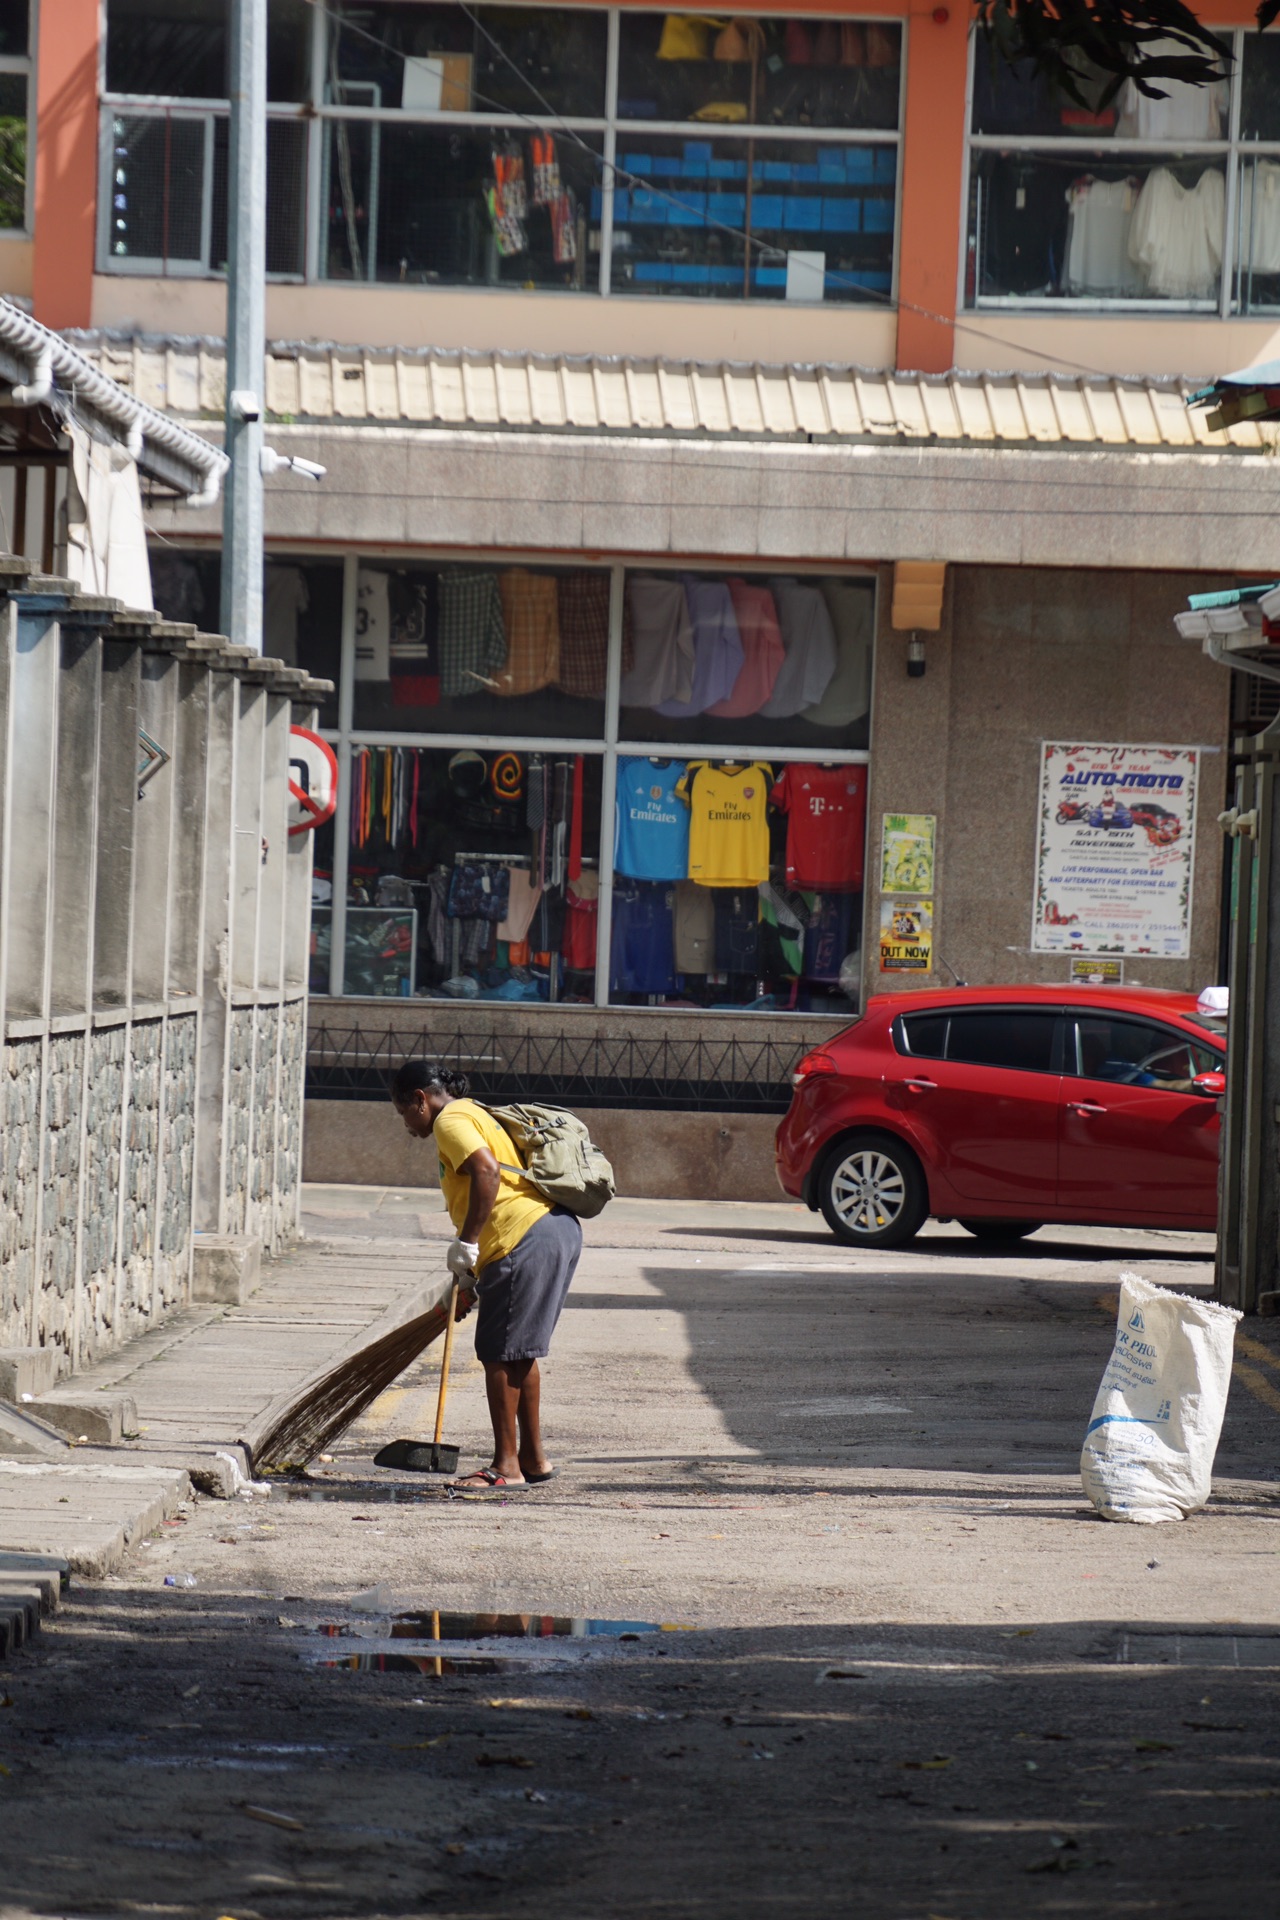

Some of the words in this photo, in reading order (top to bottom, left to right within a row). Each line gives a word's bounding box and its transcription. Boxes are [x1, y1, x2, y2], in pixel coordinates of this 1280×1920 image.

[1128, 764, 1151, 772] YEAR
[1060, 771, 1184, 788] AUTO-MOTO
[647, 801, 662, 812] Fly
[724, 802, 738, 811] Fly
[630, 808, 677, 823] Emirates
[708, 810, 751, 821] Emirates
[1076, 830, 1101, 838] SAT
[1070, 840, 1135, 848] NOVEMBER
[1130, 868, 1149, 876] OPEN
[1150, 868, 1164, 876] BAR
[1064, 876, 1106, 884] AFTERPARTY
[1107, 878, 1121, 886] FOR
[1122, 879, 1157, 887] EVERYONE
[881, 946, 902, 958] OUT
[905, 946, 930, 958] NOW
[1116, 1329, 1129, 1344] TR
[1131, 1371, 1157, 1386] sugar
[1135, 1432, 1154, 1445] 50
